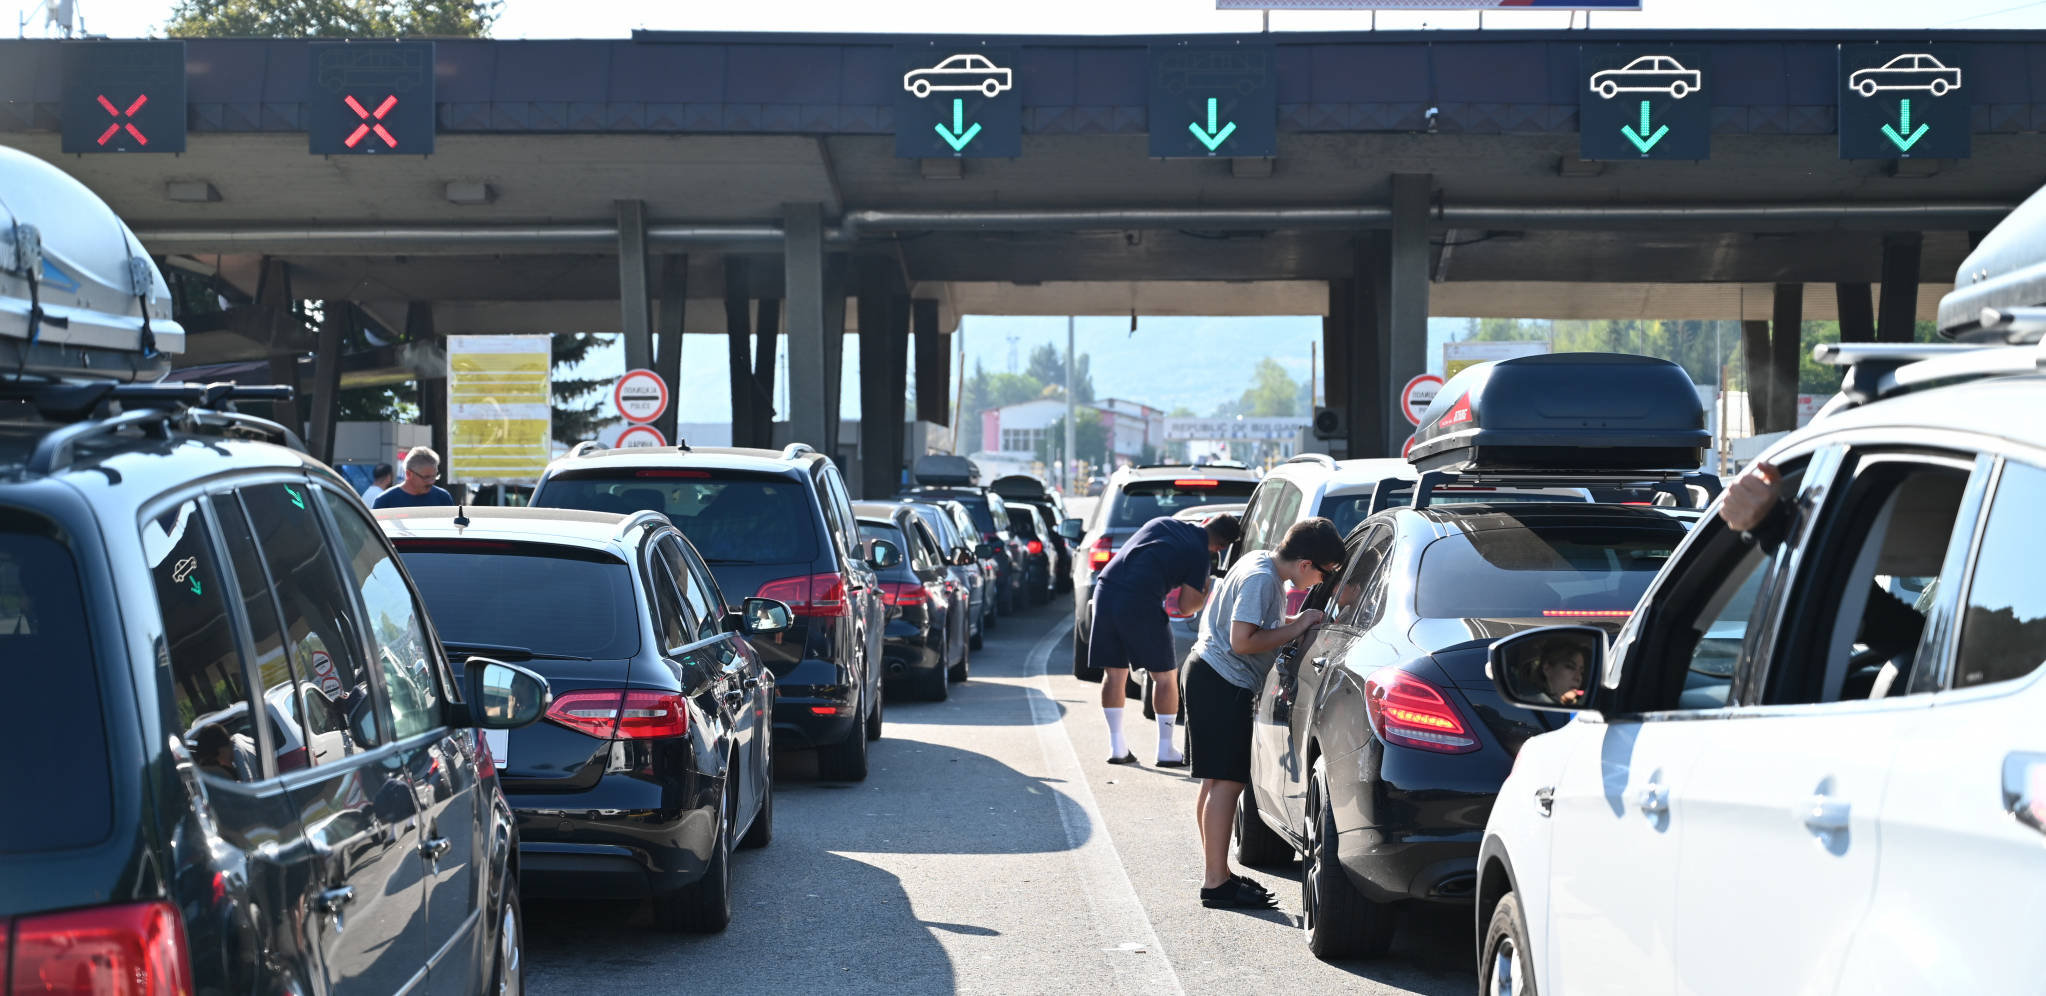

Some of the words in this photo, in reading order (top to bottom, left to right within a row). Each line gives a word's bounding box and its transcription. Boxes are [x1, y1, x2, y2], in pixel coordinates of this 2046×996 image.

[1172, 423, 1228, 433] REPUBLIC
[1232, 423, 1247, 433] OF
[1251, 423, 1300, 433] BULGAR
